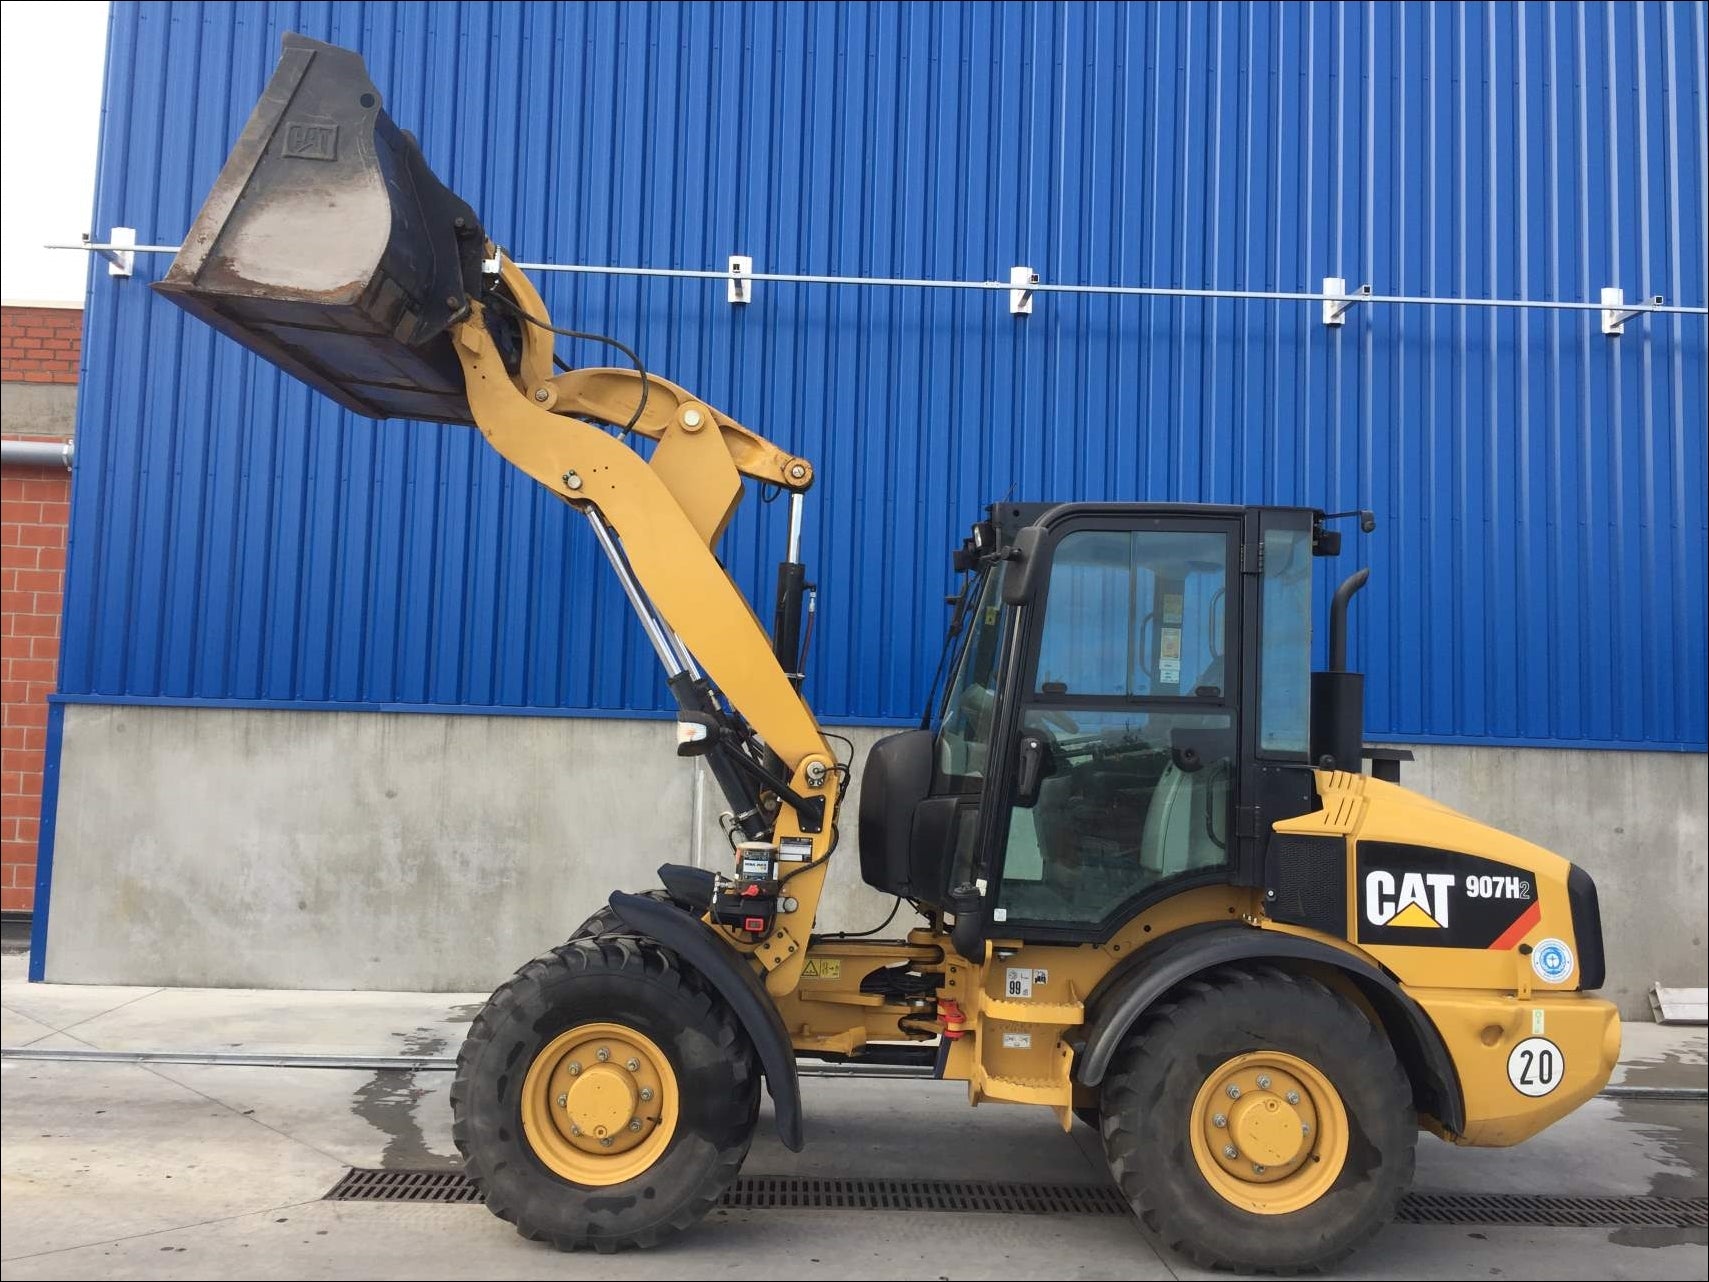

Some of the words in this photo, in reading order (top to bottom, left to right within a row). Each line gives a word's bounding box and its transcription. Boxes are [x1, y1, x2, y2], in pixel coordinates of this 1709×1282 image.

[287, 125, 335, 157] CAT
[1365, 870, 1456, 928] CAT
[1465, 875, 1531, 900] 907H2
[1009, 980, 1021, 995] 99
[1519, 1049, 1553, 1086] 20
